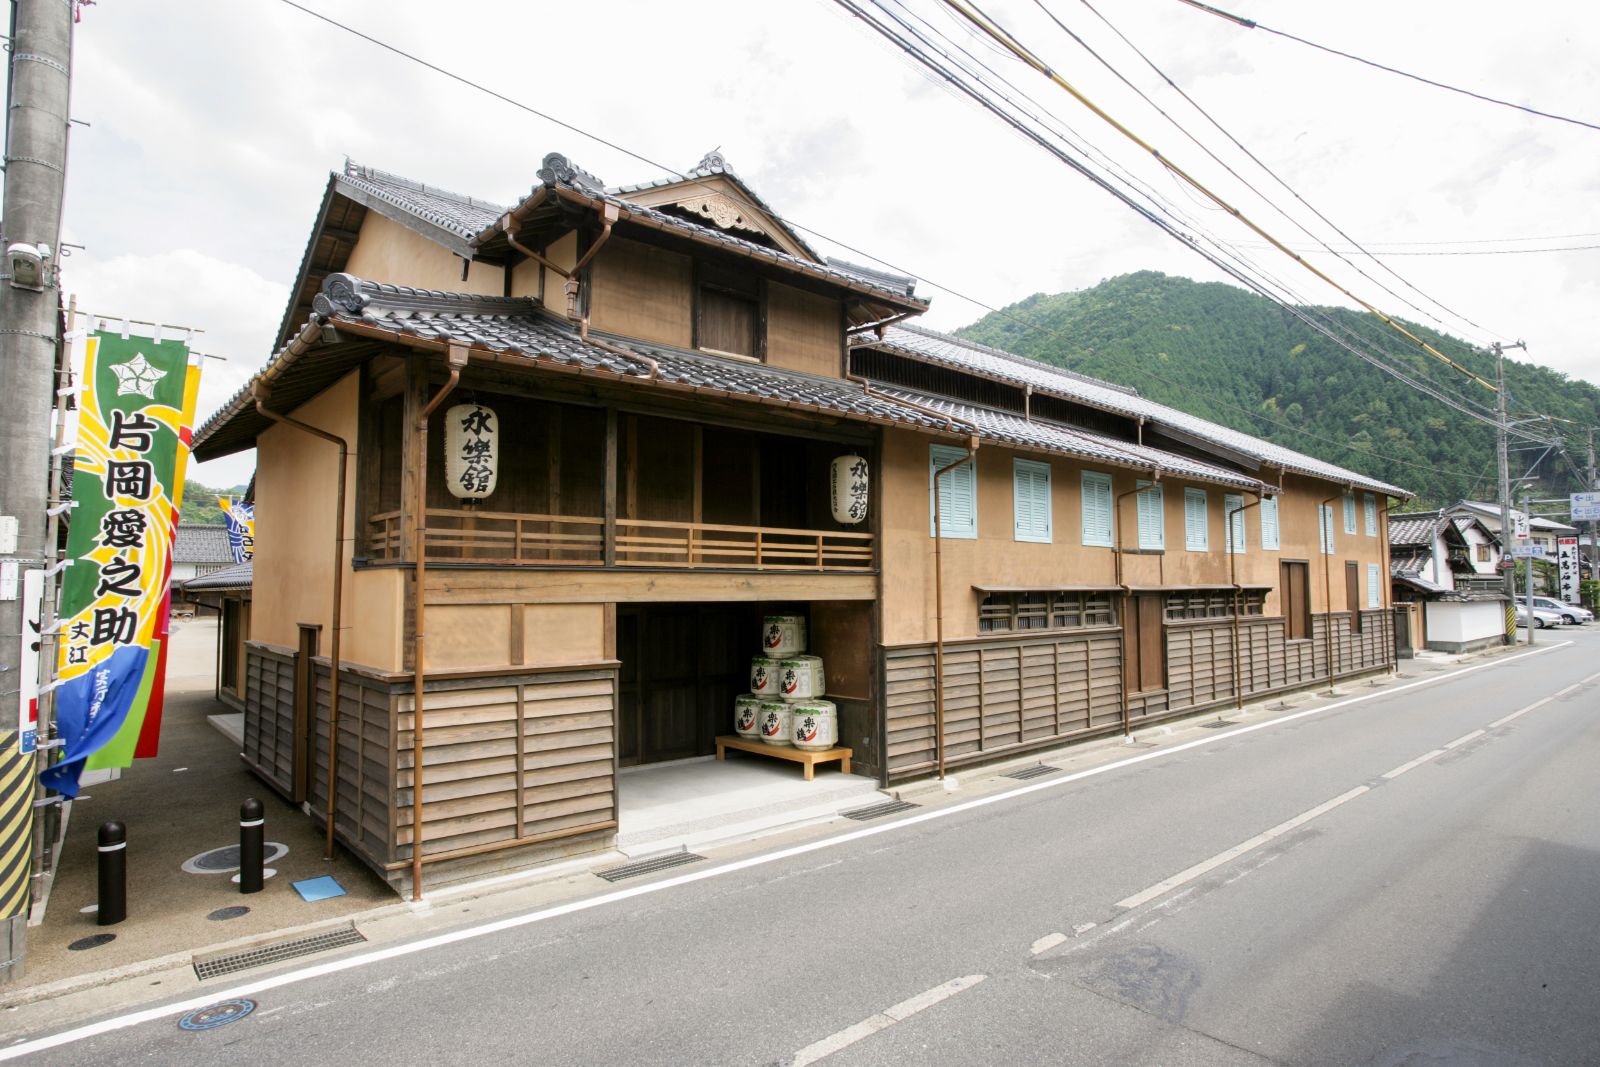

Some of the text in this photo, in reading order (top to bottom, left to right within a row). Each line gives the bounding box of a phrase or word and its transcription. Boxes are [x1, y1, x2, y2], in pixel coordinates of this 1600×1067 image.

[90, 411, 159, 646] 片岡愛之助
